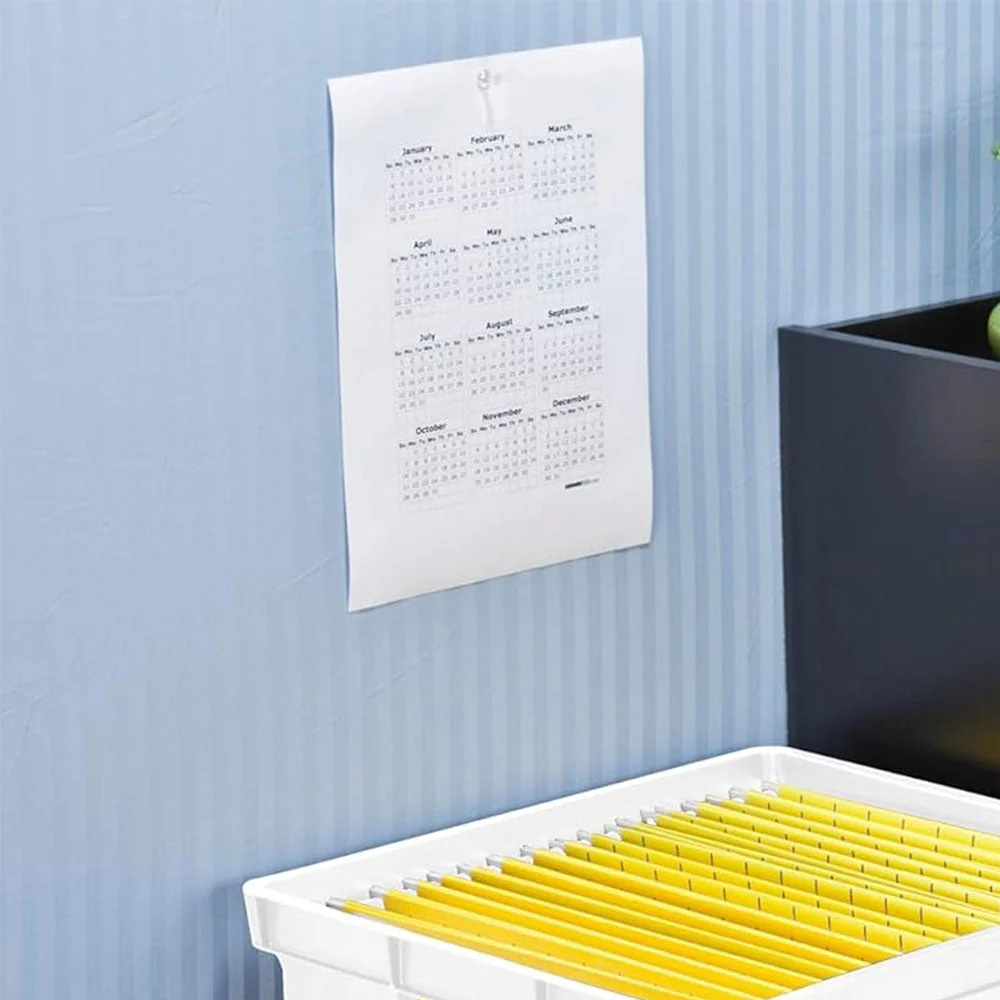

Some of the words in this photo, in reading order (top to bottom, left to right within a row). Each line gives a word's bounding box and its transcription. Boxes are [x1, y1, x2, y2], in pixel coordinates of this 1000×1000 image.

[548, 123, 572, 133] March
[470, 134, 505, 144] February
[402, 145, 432, 156] January
[554, 216, 573, 225] June
[486, 228, 502, 237] May
[413, 239, 432, 249] April
[547, 304, 589, 318] September
[485, 318, 513, 330] August
[419, 333, 436, 344] July
[552, 394, 590, 407] December
[482, 408, 522, 420] November
[415, 423, 446, 435] October
